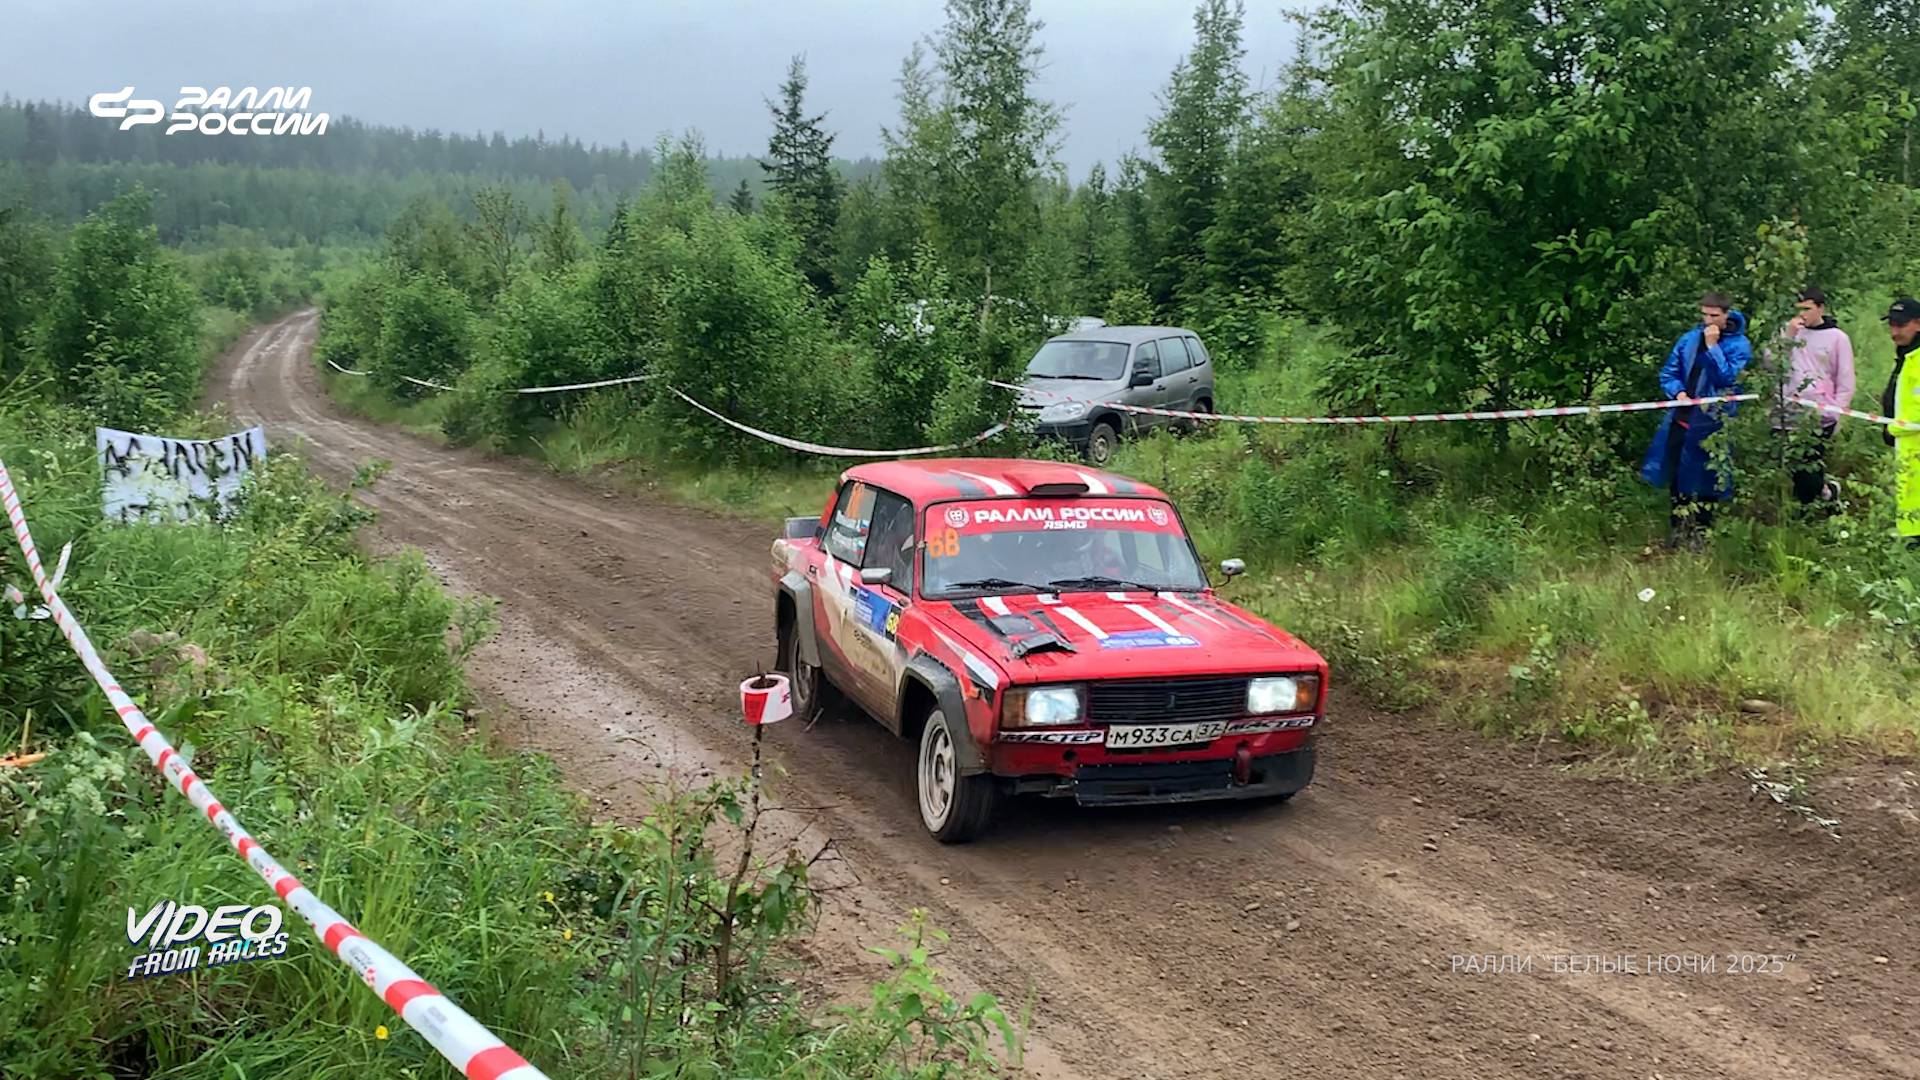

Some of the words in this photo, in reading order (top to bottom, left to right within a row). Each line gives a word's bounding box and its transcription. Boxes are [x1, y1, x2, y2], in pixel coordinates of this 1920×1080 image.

[974, 507, 1051, 523] РАЛЛИ
[1060, 507, 1144, 521] РОССИИ
[1227, 717, 1314, 732] МАСТЕР
[1003, 731, 1101, 742] МАСТЕР
